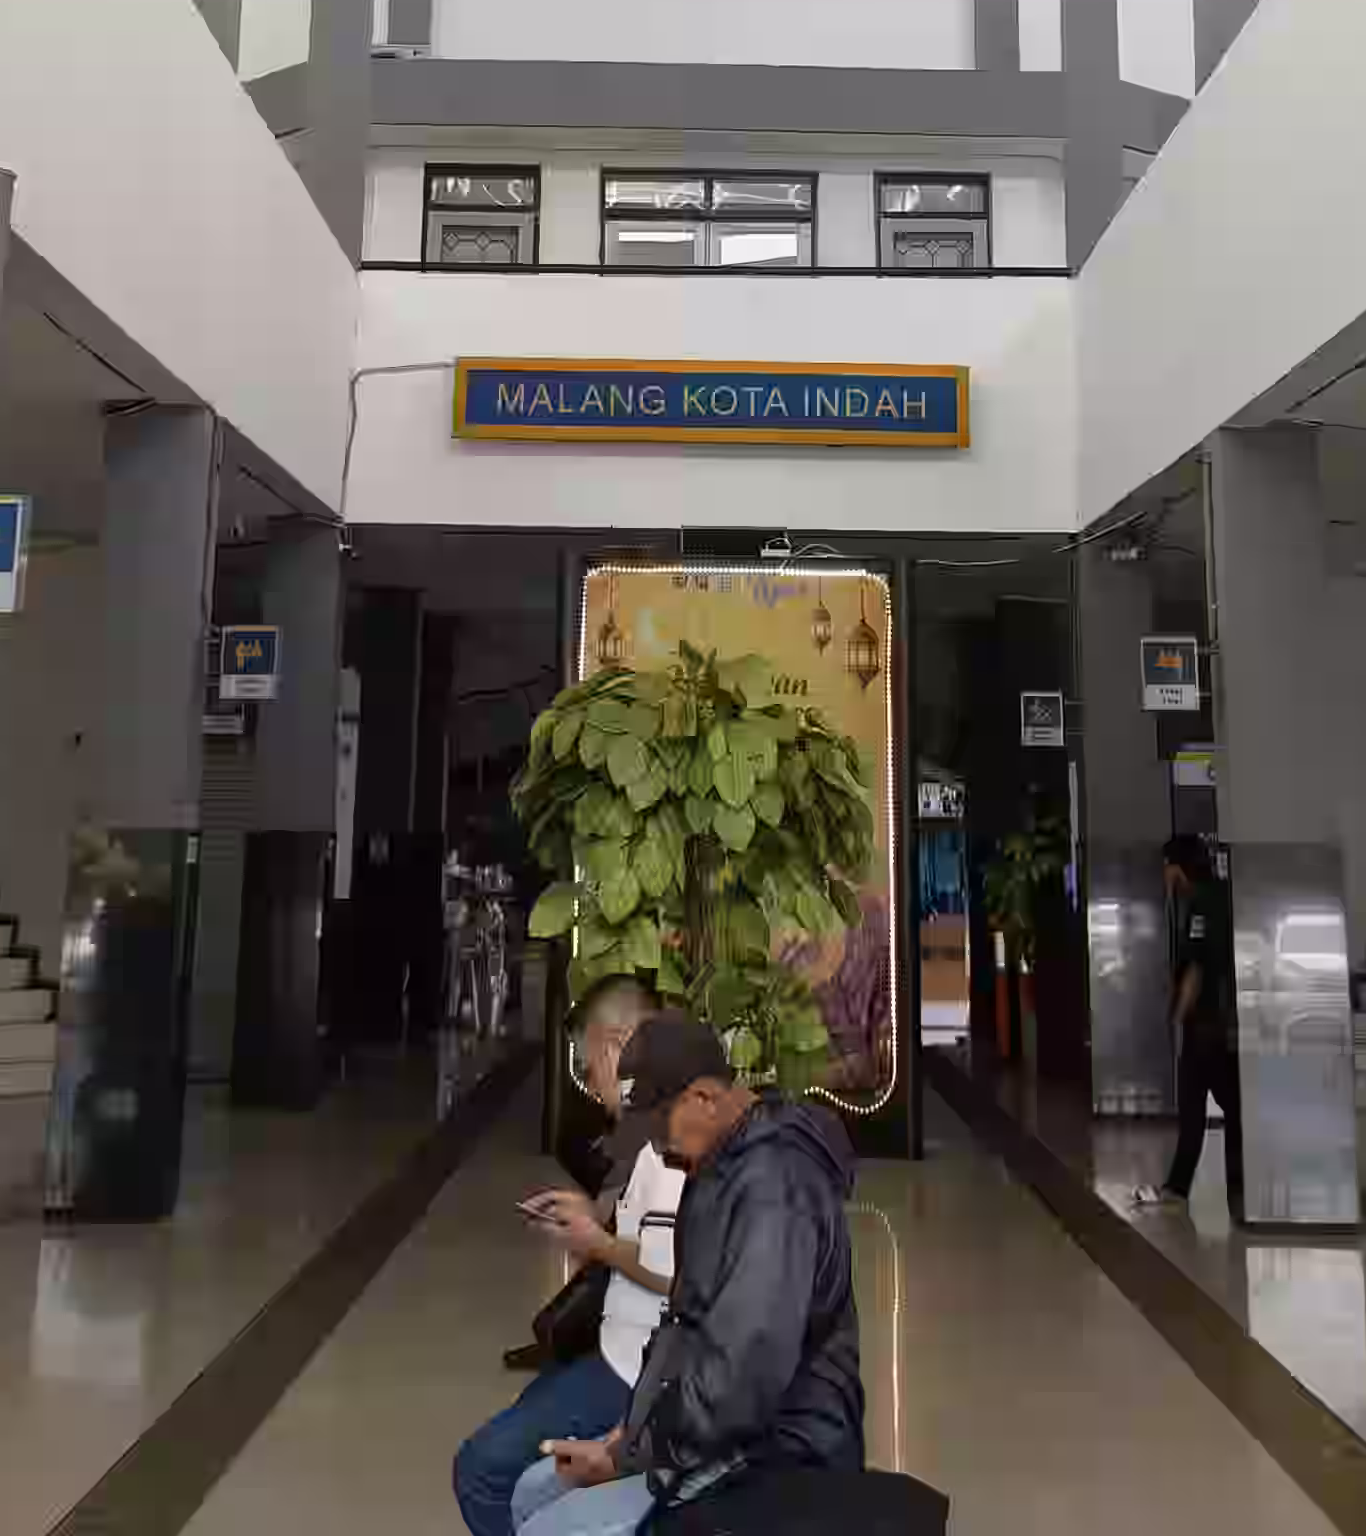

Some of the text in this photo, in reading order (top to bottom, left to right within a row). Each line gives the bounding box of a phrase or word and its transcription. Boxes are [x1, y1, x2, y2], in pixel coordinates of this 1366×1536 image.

[495, 381, 927, 420] MALANG KOTA INDAH
